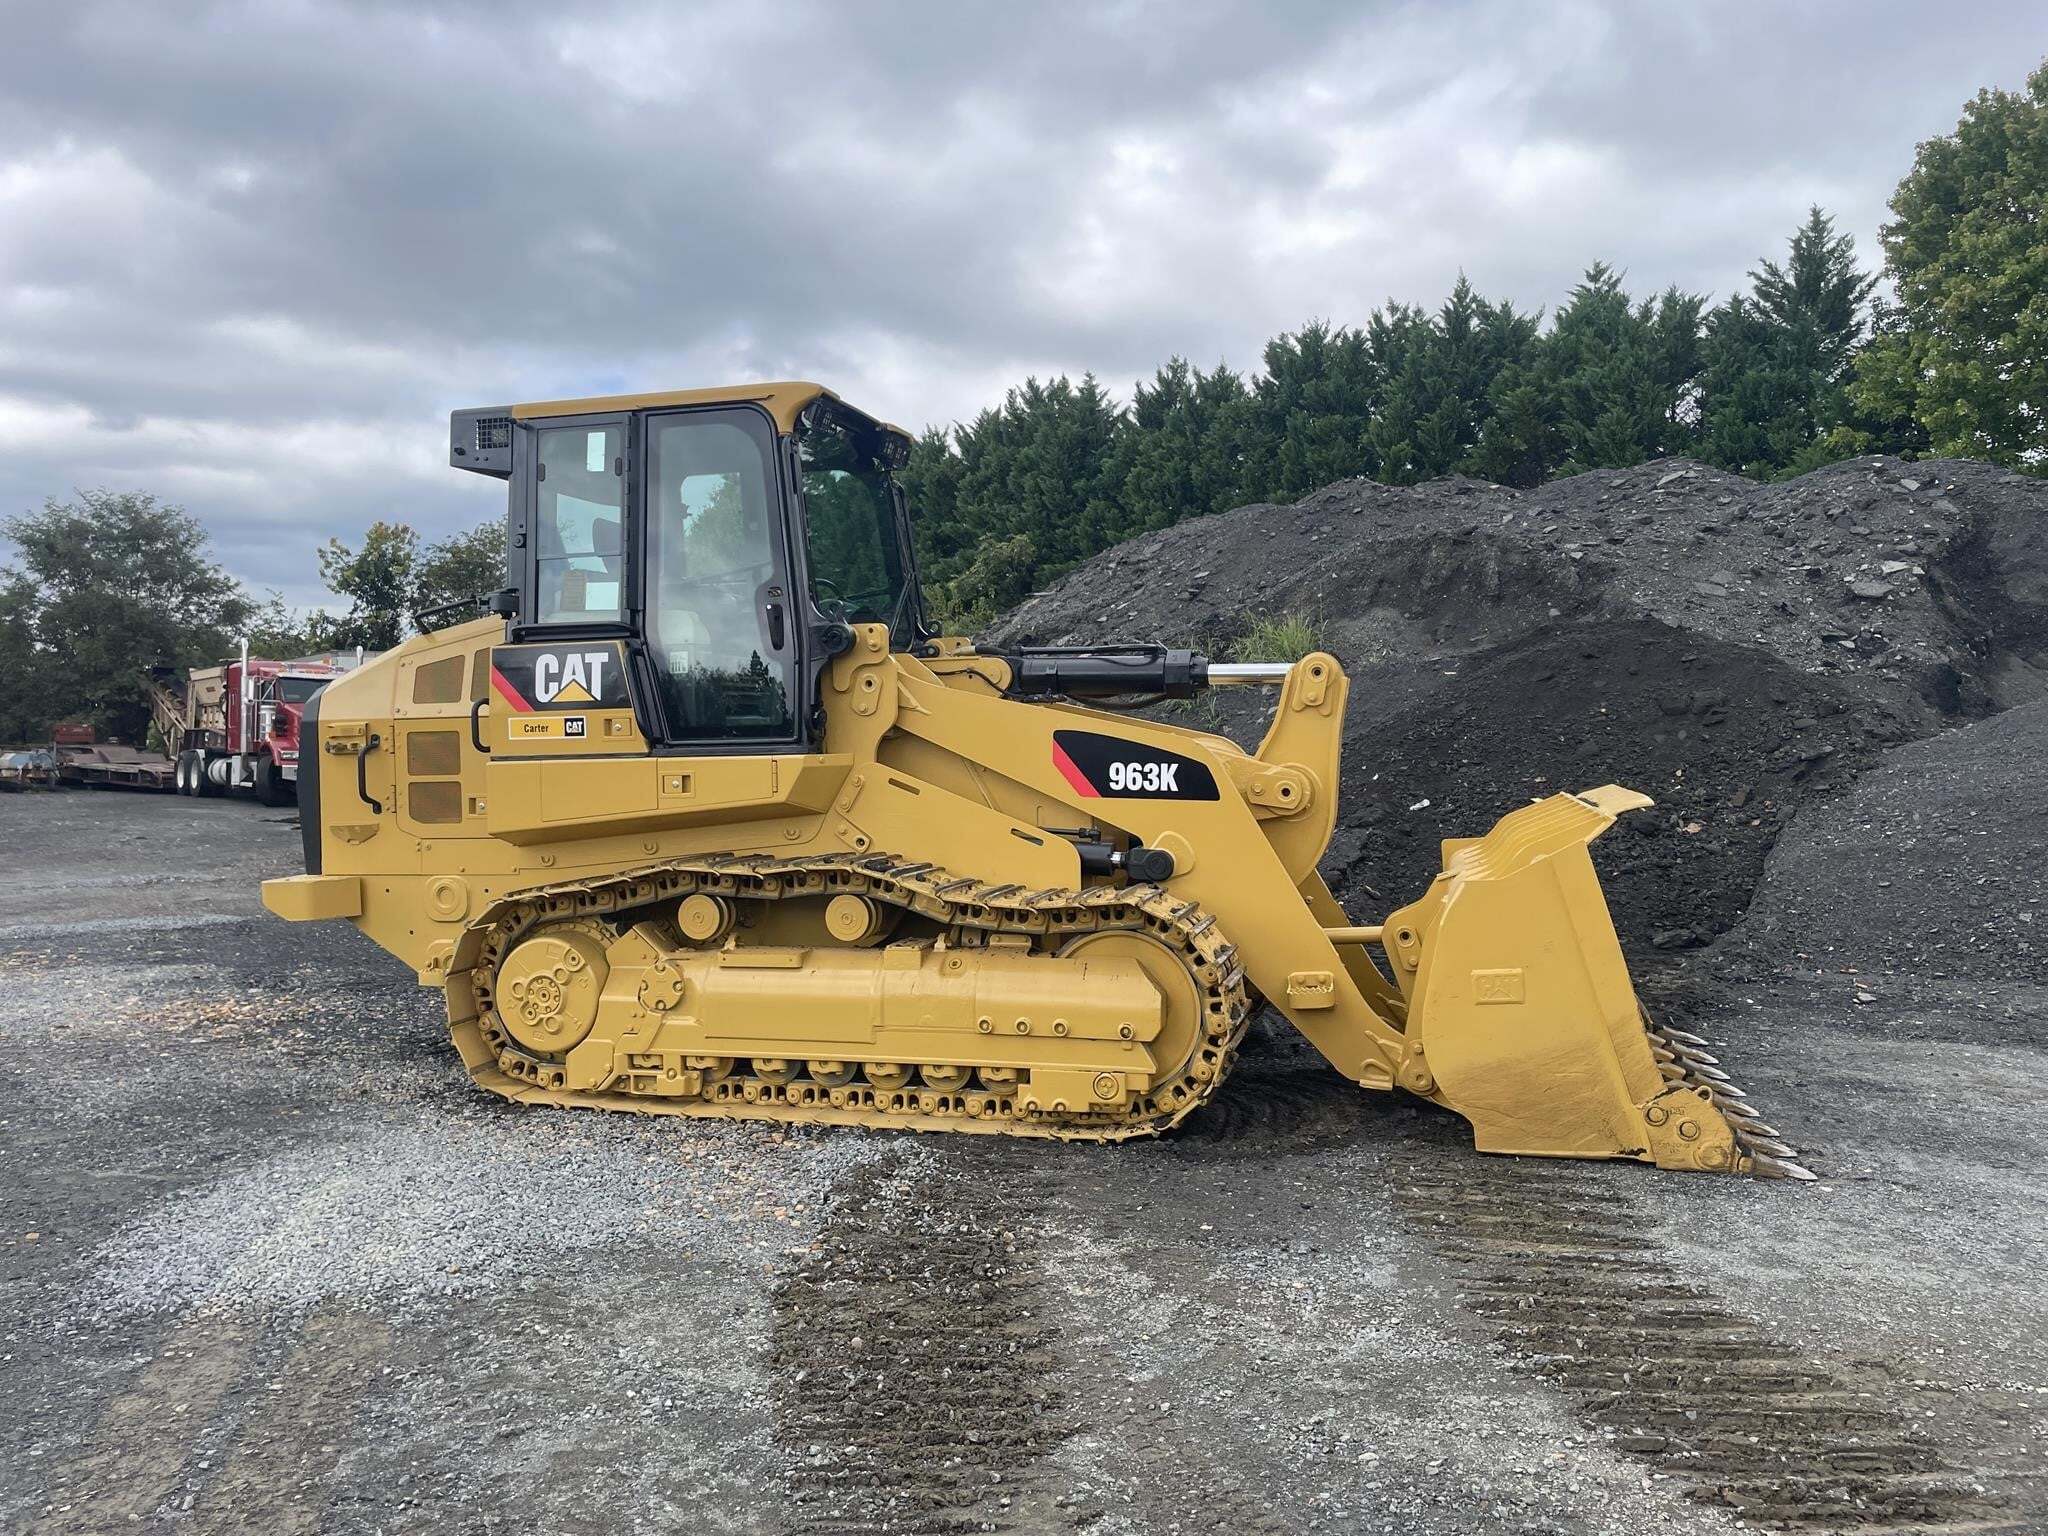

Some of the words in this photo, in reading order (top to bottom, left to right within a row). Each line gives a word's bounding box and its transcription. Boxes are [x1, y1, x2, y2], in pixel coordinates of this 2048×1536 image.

[535, 652, 609, 703] CAT
[523, 723, 549, 733] Carter
[565, 721, 583, 733] CAT
[1108, 761, 1179, 792] 963K
